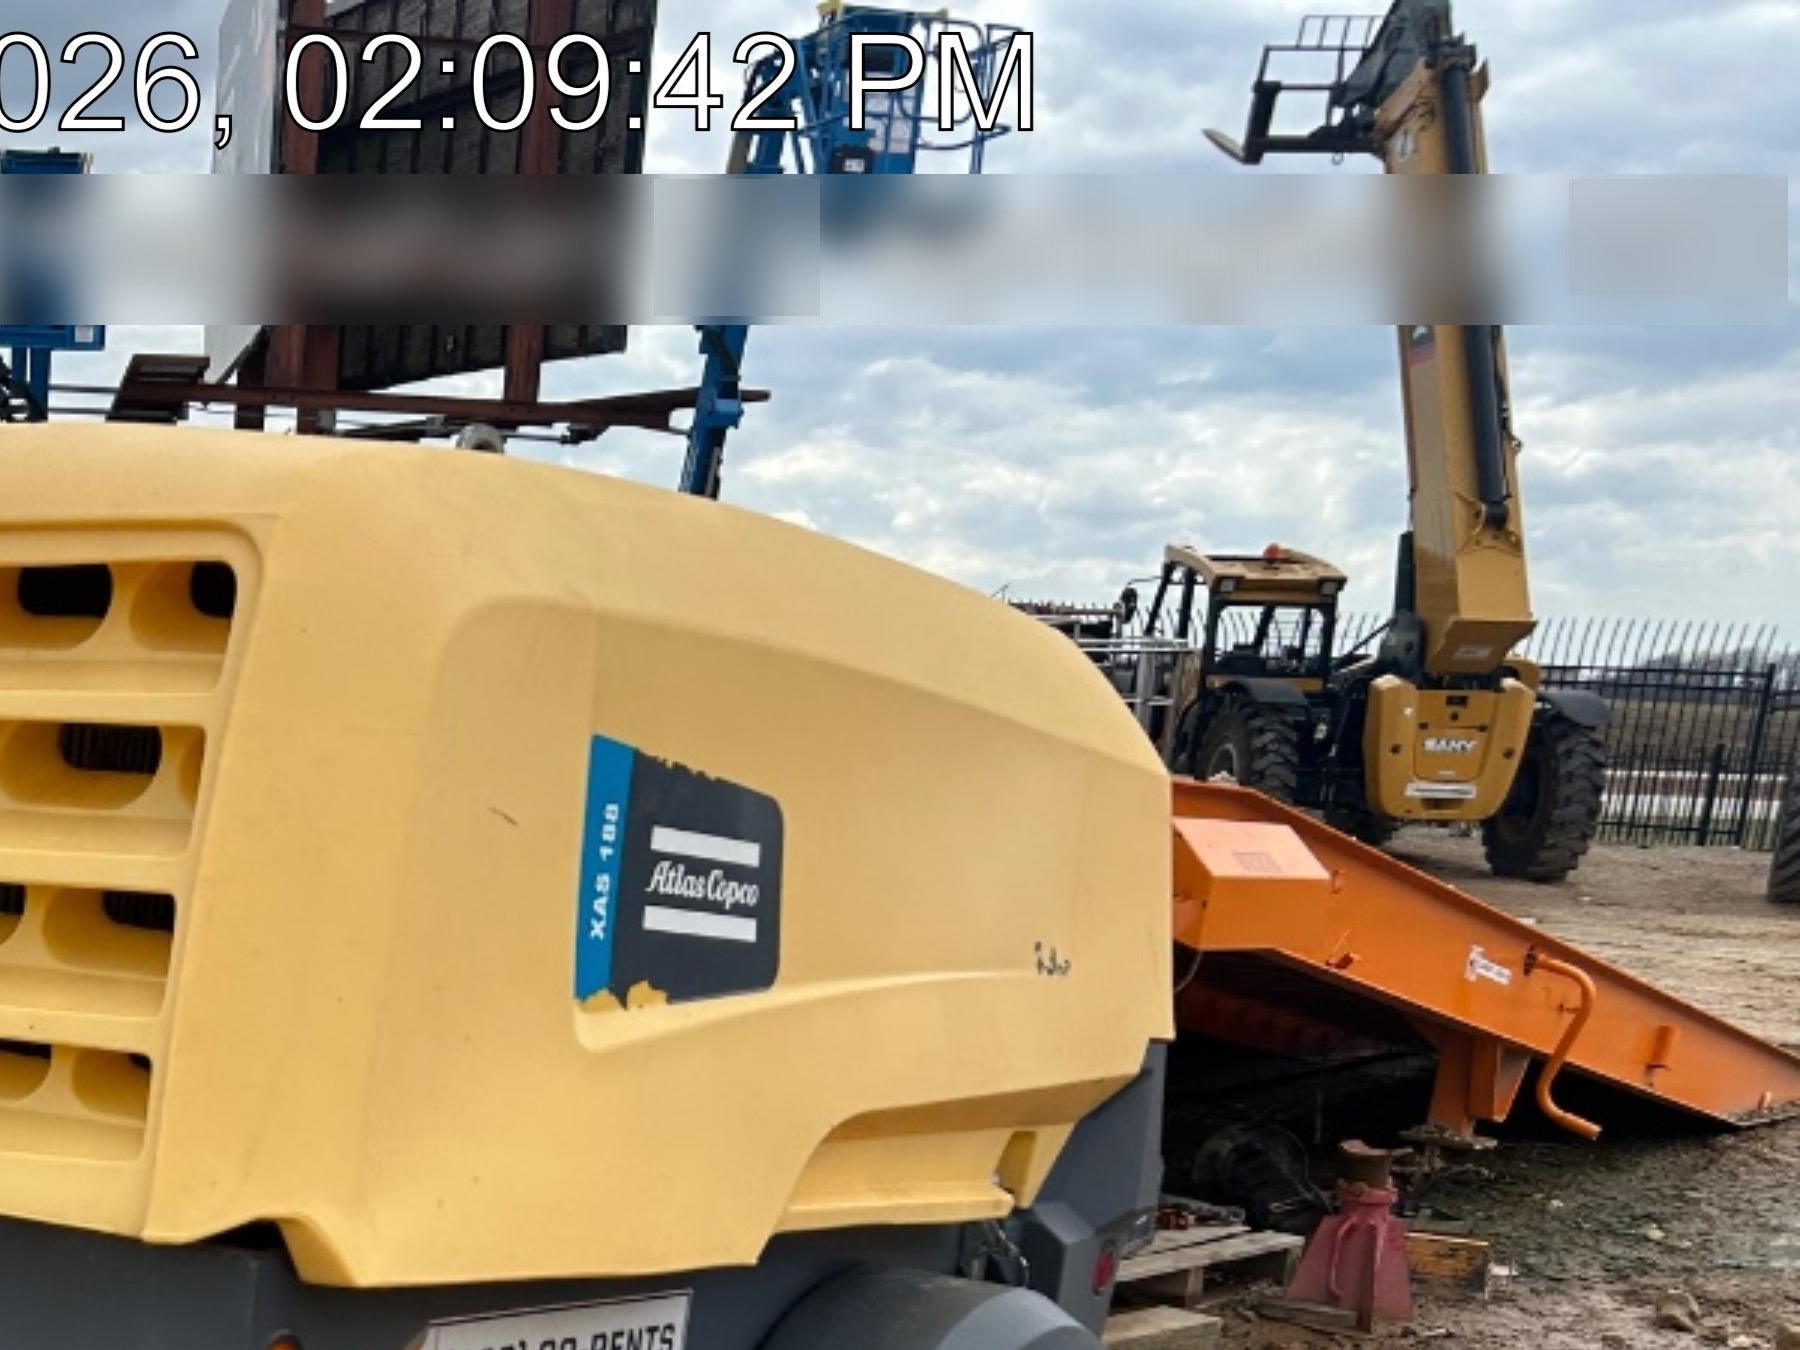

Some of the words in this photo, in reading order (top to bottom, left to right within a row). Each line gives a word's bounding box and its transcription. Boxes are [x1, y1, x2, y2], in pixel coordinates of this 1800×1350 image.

[599, 803, 619, 862] 188
[590, 872, 611, 941] XAS
[644, 860, 707, 899] Atlas
[706, 869, 760, 911] Copco
